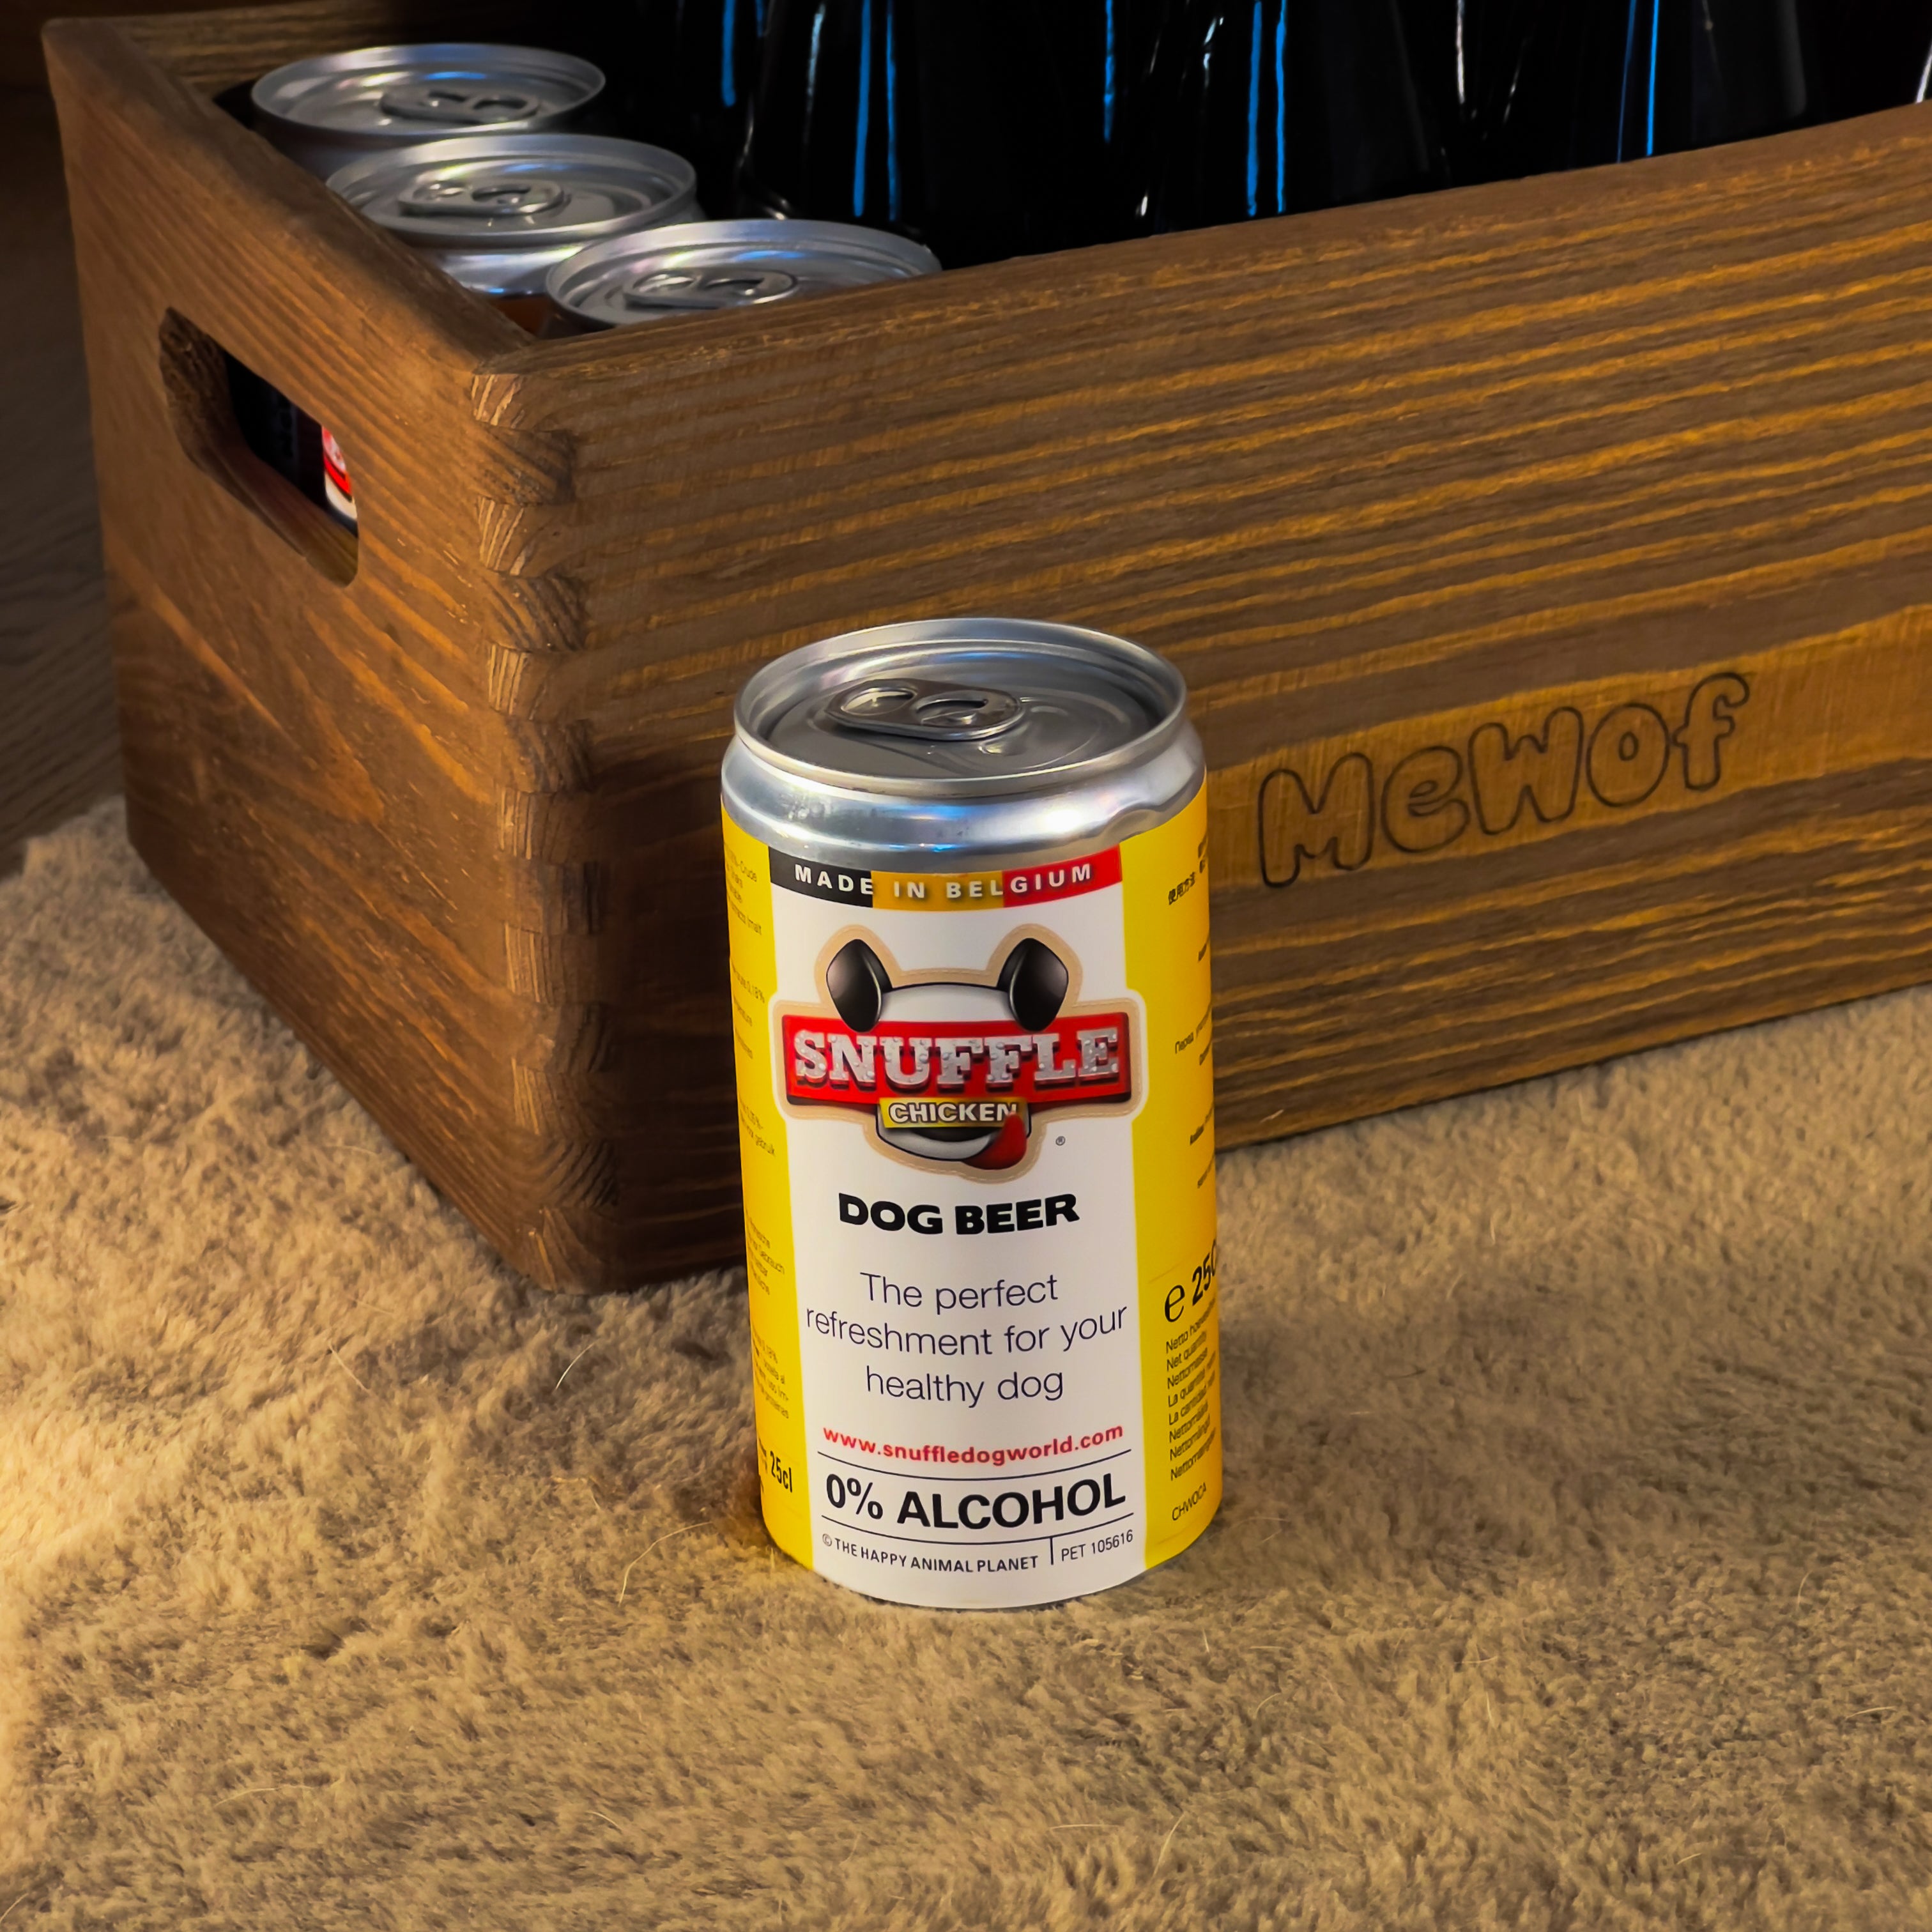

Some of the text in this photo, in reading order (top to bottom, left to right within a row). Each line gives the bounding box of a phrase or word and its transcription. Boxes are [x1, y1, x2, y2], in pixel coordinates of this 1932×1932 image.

[794, 863, 1091, 899] MADE IN BELGIUM
[793, 1026, 1120, 1094] SNUFFLE
[888, 1101, 1018, 1124] CHICKEN
[838, 1192, 1080, 1235] DOG BEER
[860, 1271, 1059, 1315] The perfect
[806, 1308, 993, 1356] refreshment
[1004, 1324, 1050, 1353] for
[1060, 1305, 1128, 1352] your
[1166, 1331, 1188, 1354] Netto
[1167, 1353, 1183, 1372] Net
[866, 1365, 1063, 1409] healthy dog
[1169, 1392, 1179, 1407] La
[1169, 1409, 1179, 1426] La
[823, 1425, 1124, 1467] www.snuffledogworld.com
[770, 1450, 793, 1493] 25cl
[825, 1473, 1126, 1530] 0% ALCOHOL
[834, 1537, 858, 1557] THE
[860, 1545, 907, 1567] HAPPY
[910, 1556, 974, 1573] ANIMAL
[976, 1555, 1039, 1573] PLANET
[1061, 1528, 1134, 1562] PET 105616
